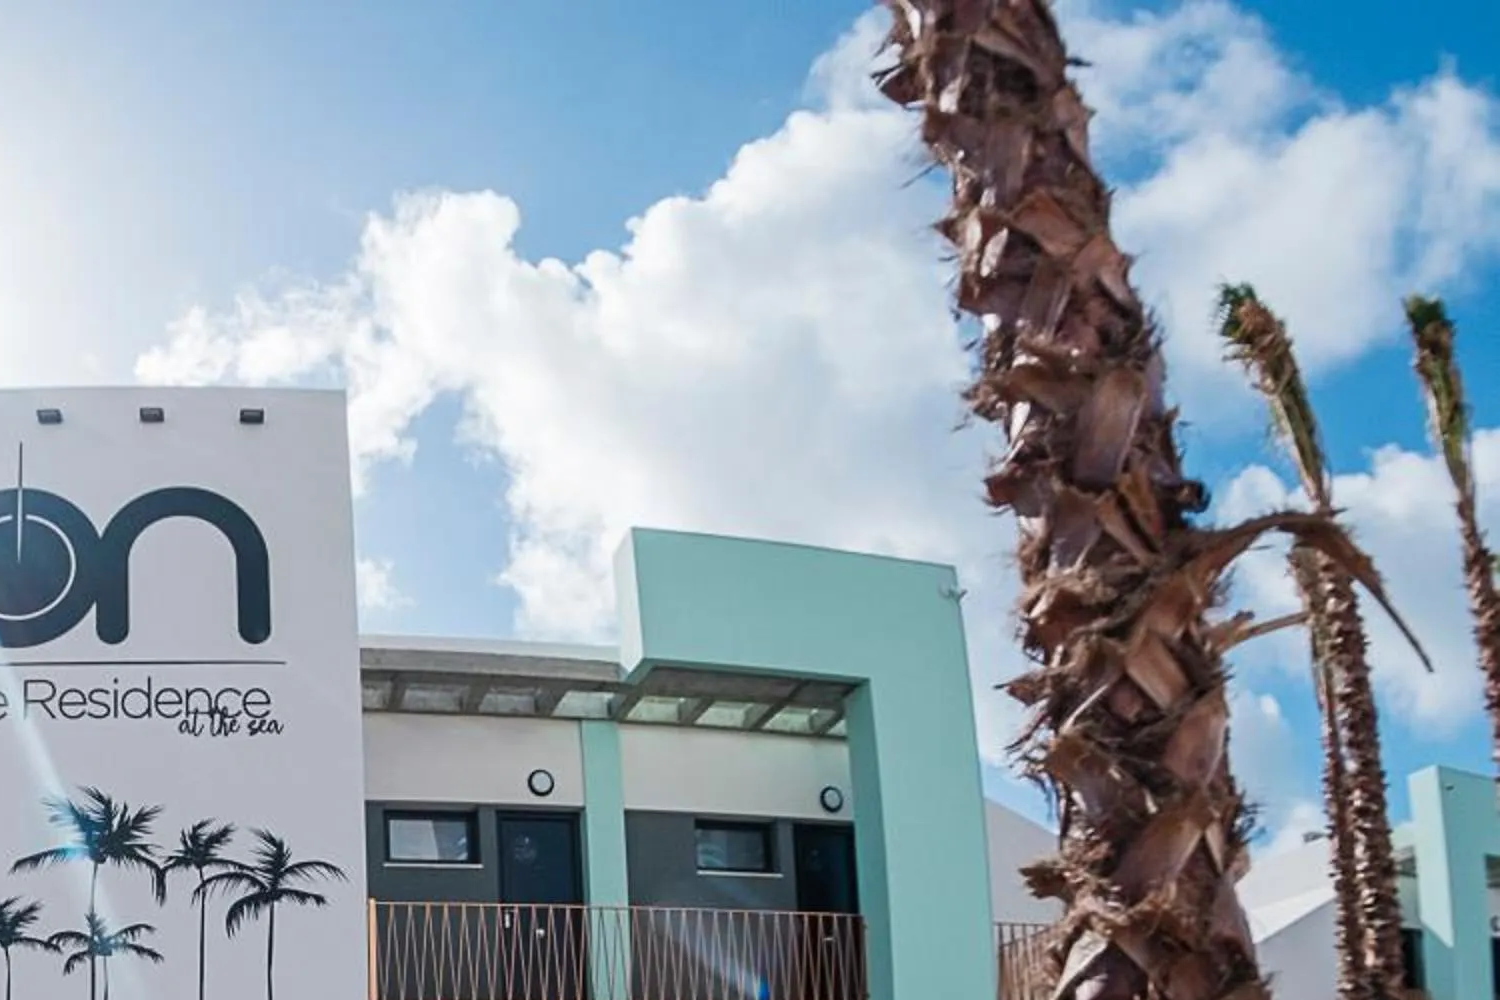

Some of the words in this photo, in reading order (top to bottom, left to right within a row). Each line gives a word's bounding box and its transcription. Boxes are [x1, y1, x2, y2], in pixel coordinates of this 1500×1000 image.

[22, 676, 272, 720] Residence
[177, 706, 205, 737] at
[209, 705, 241, 737] the
[247, 718, 285, 737] sea
